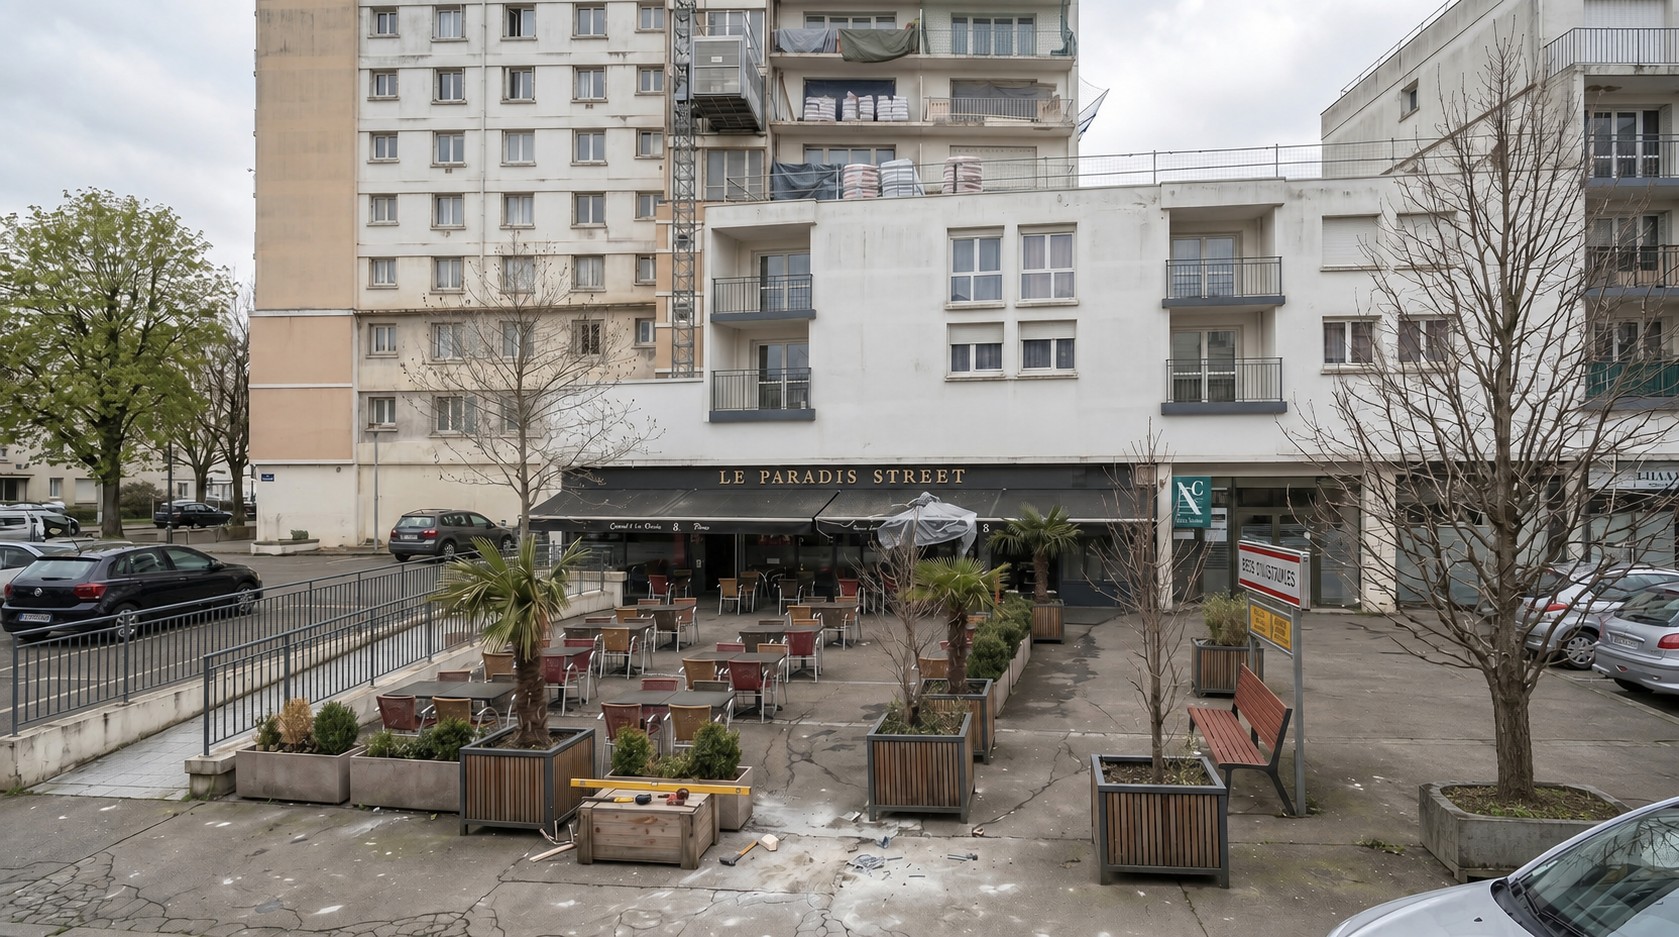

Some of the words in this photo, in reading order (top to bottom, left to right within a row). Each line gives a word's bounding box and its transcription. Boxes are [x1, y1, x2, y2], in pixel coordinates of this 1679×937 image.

[718, 469, 745, 485] LE
[758, 469, 859, 485] PARADIS
[872, 468, 967, 485] STREET
